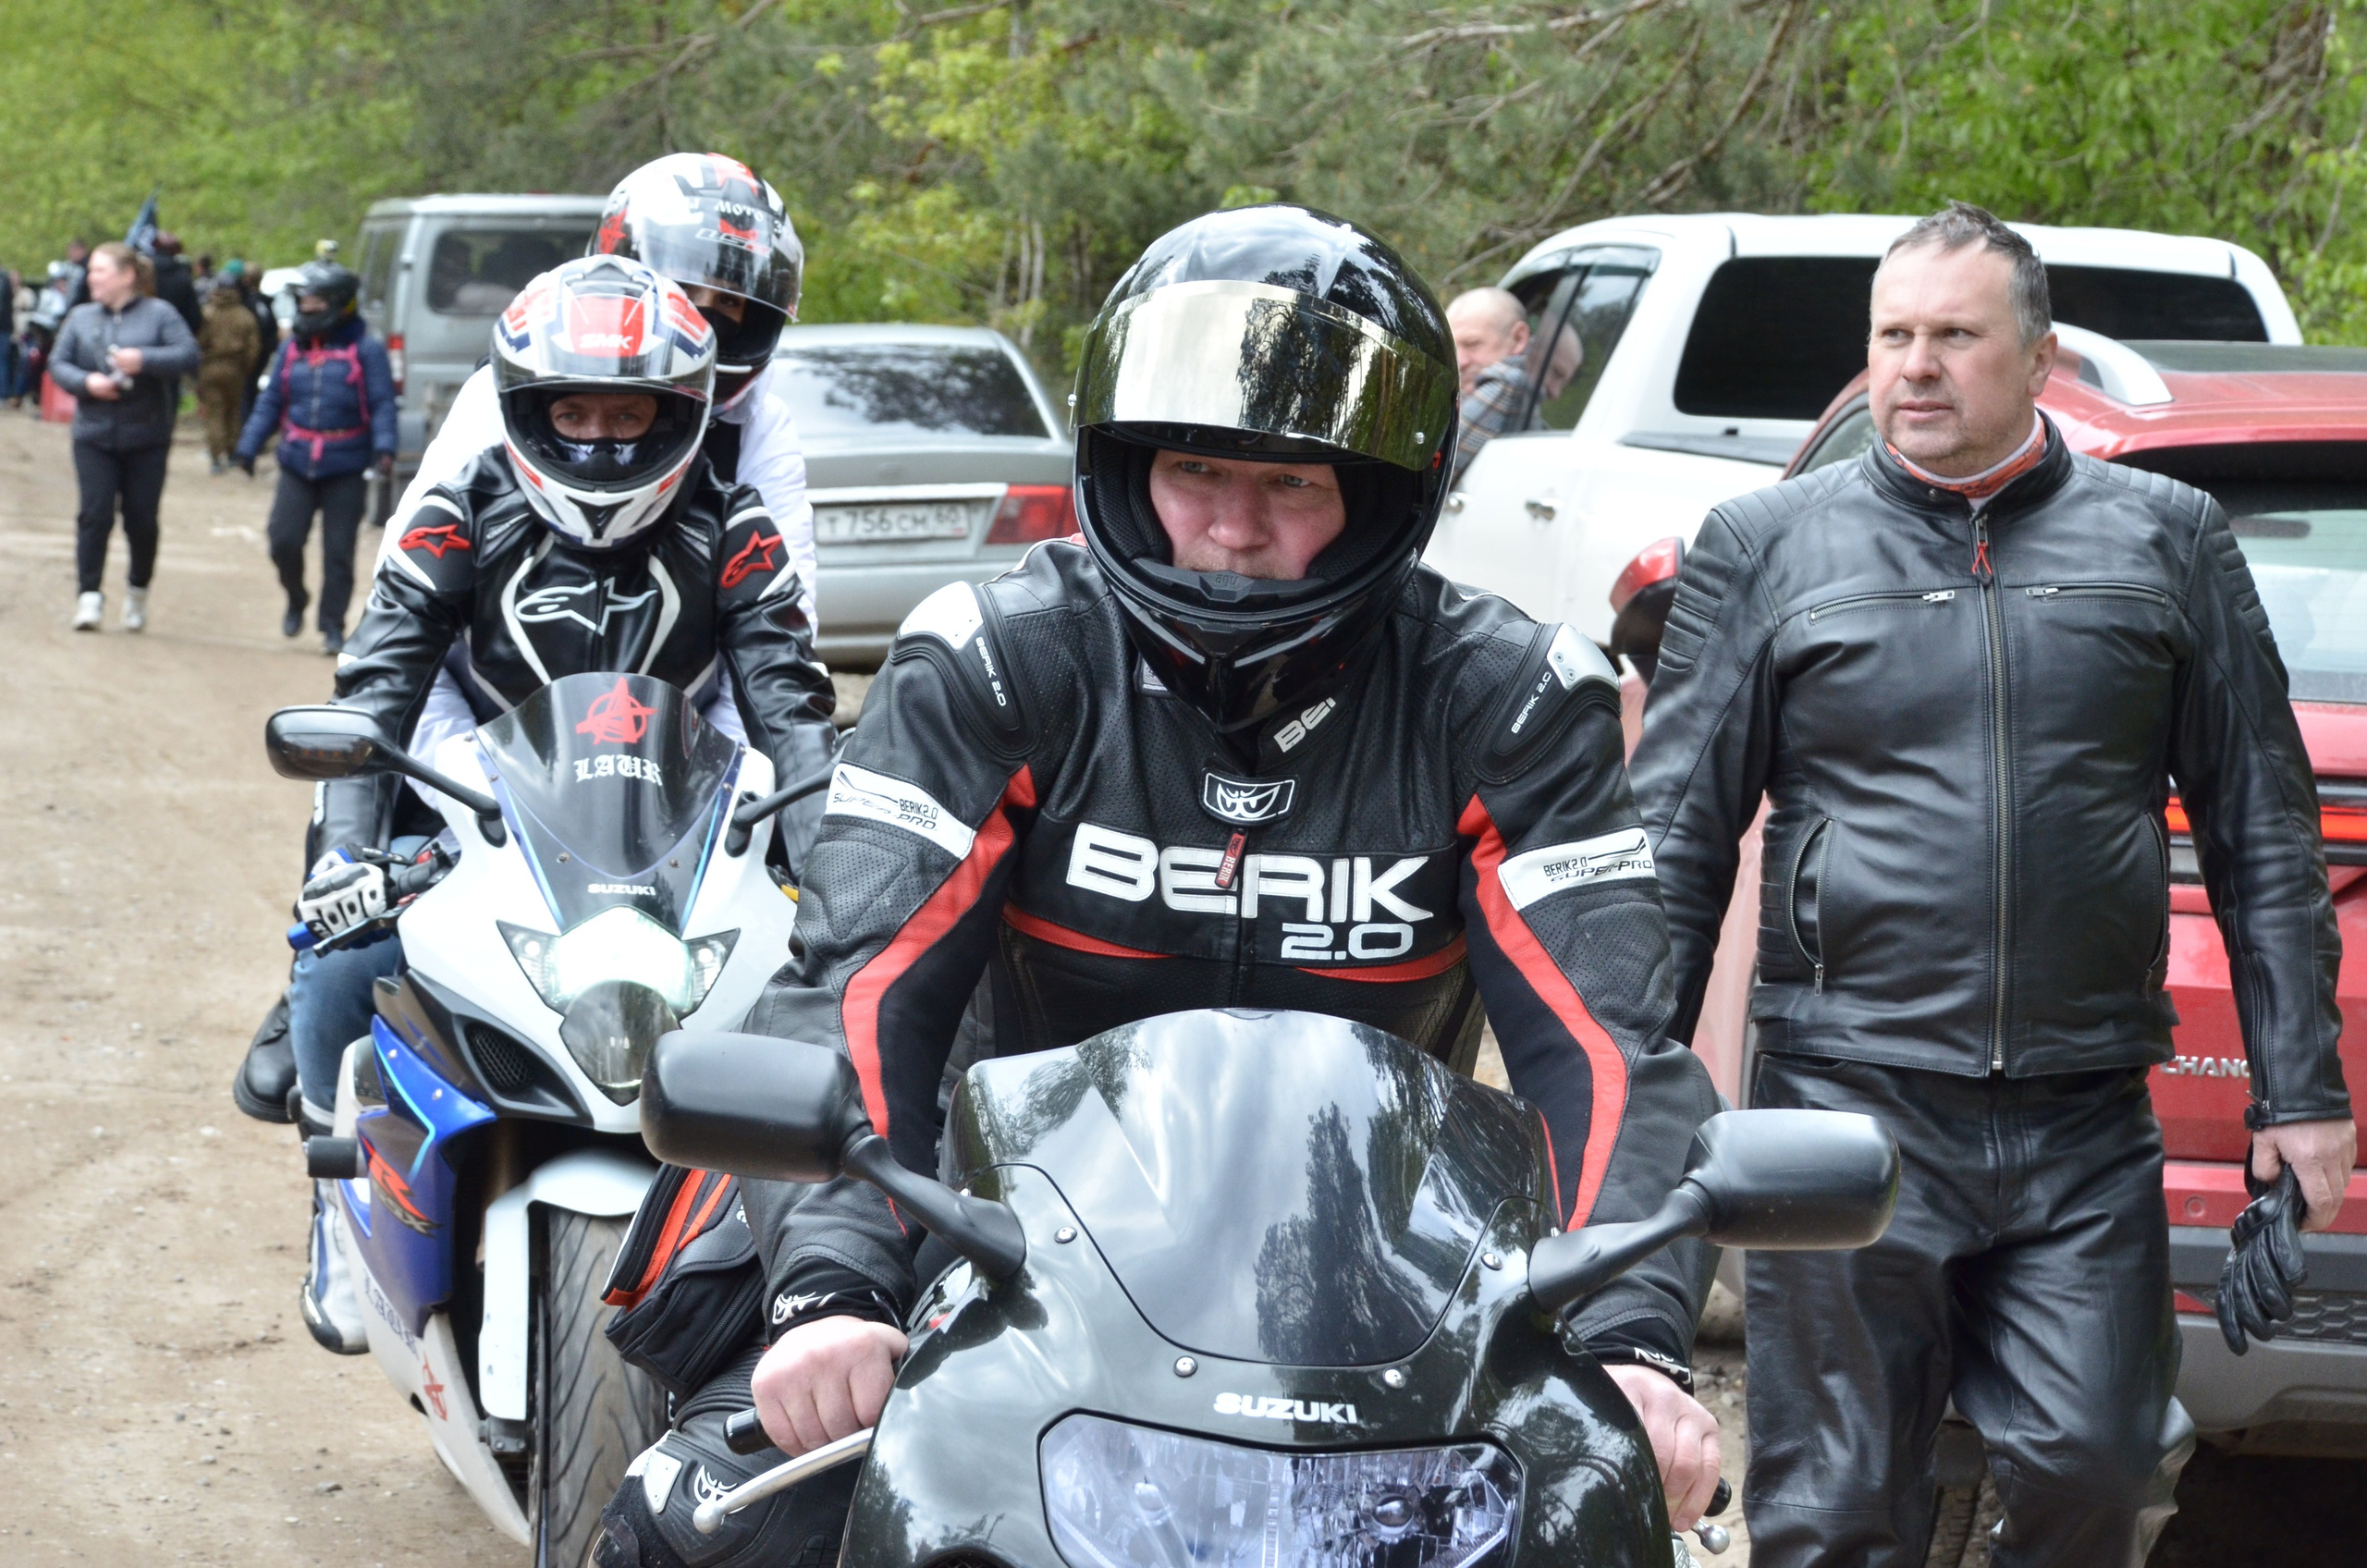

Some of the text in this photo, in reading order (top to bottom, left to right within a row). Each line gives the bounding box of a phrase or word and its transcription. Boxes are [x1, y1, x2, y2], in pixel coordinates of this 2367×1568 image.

[714, 200, 764, 222] MOTO
[579, 333, 633, 349] SMK
[975, 636, 1007, 706] BERIK 2.0
[1511, 671, 1551, 733] BERIK 2.0
[1066, 822, 1434, 923] BERIK
[1218, 855, 1236, 883] BERIK
[587, 883, 656, 896] SUZUKI
[1281, 922, 1414, 961] 2.0
[1213, 1391, 1358, 1424] SUZUKI
